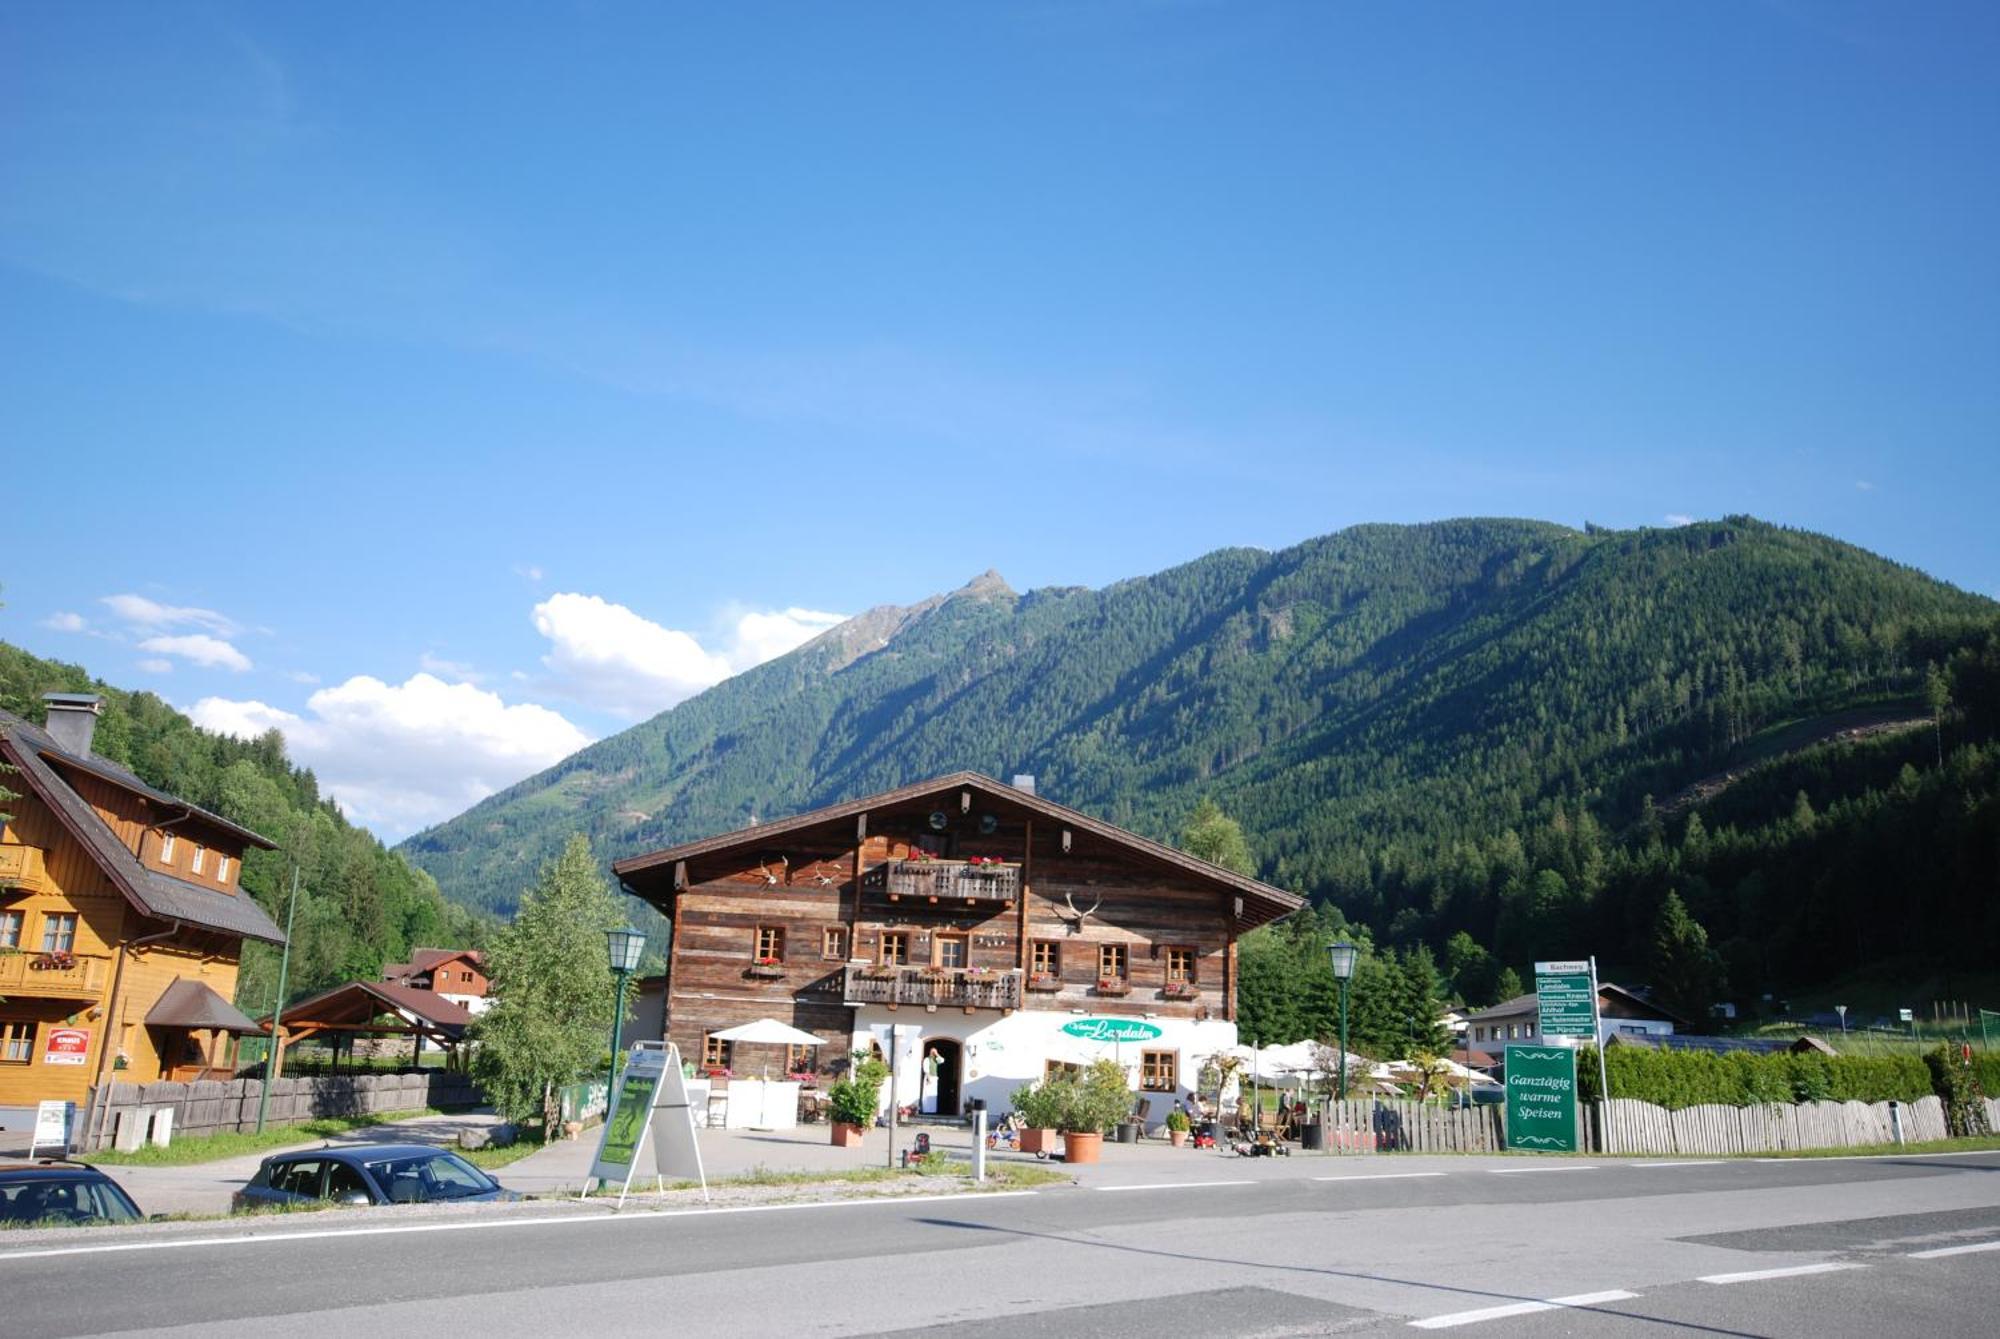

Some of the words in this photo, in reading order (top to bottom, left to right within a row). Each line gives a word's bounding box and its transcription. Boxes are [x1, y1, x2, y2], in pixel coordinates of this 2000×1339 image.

[1084, 1020, 1154, 1040] Landalm
[1509, 1074, 1571, 1091] Ganztägig
[1520, 1092, 1562, 1103] warme
[1518, 1106, 1562, 1120] Speisen
